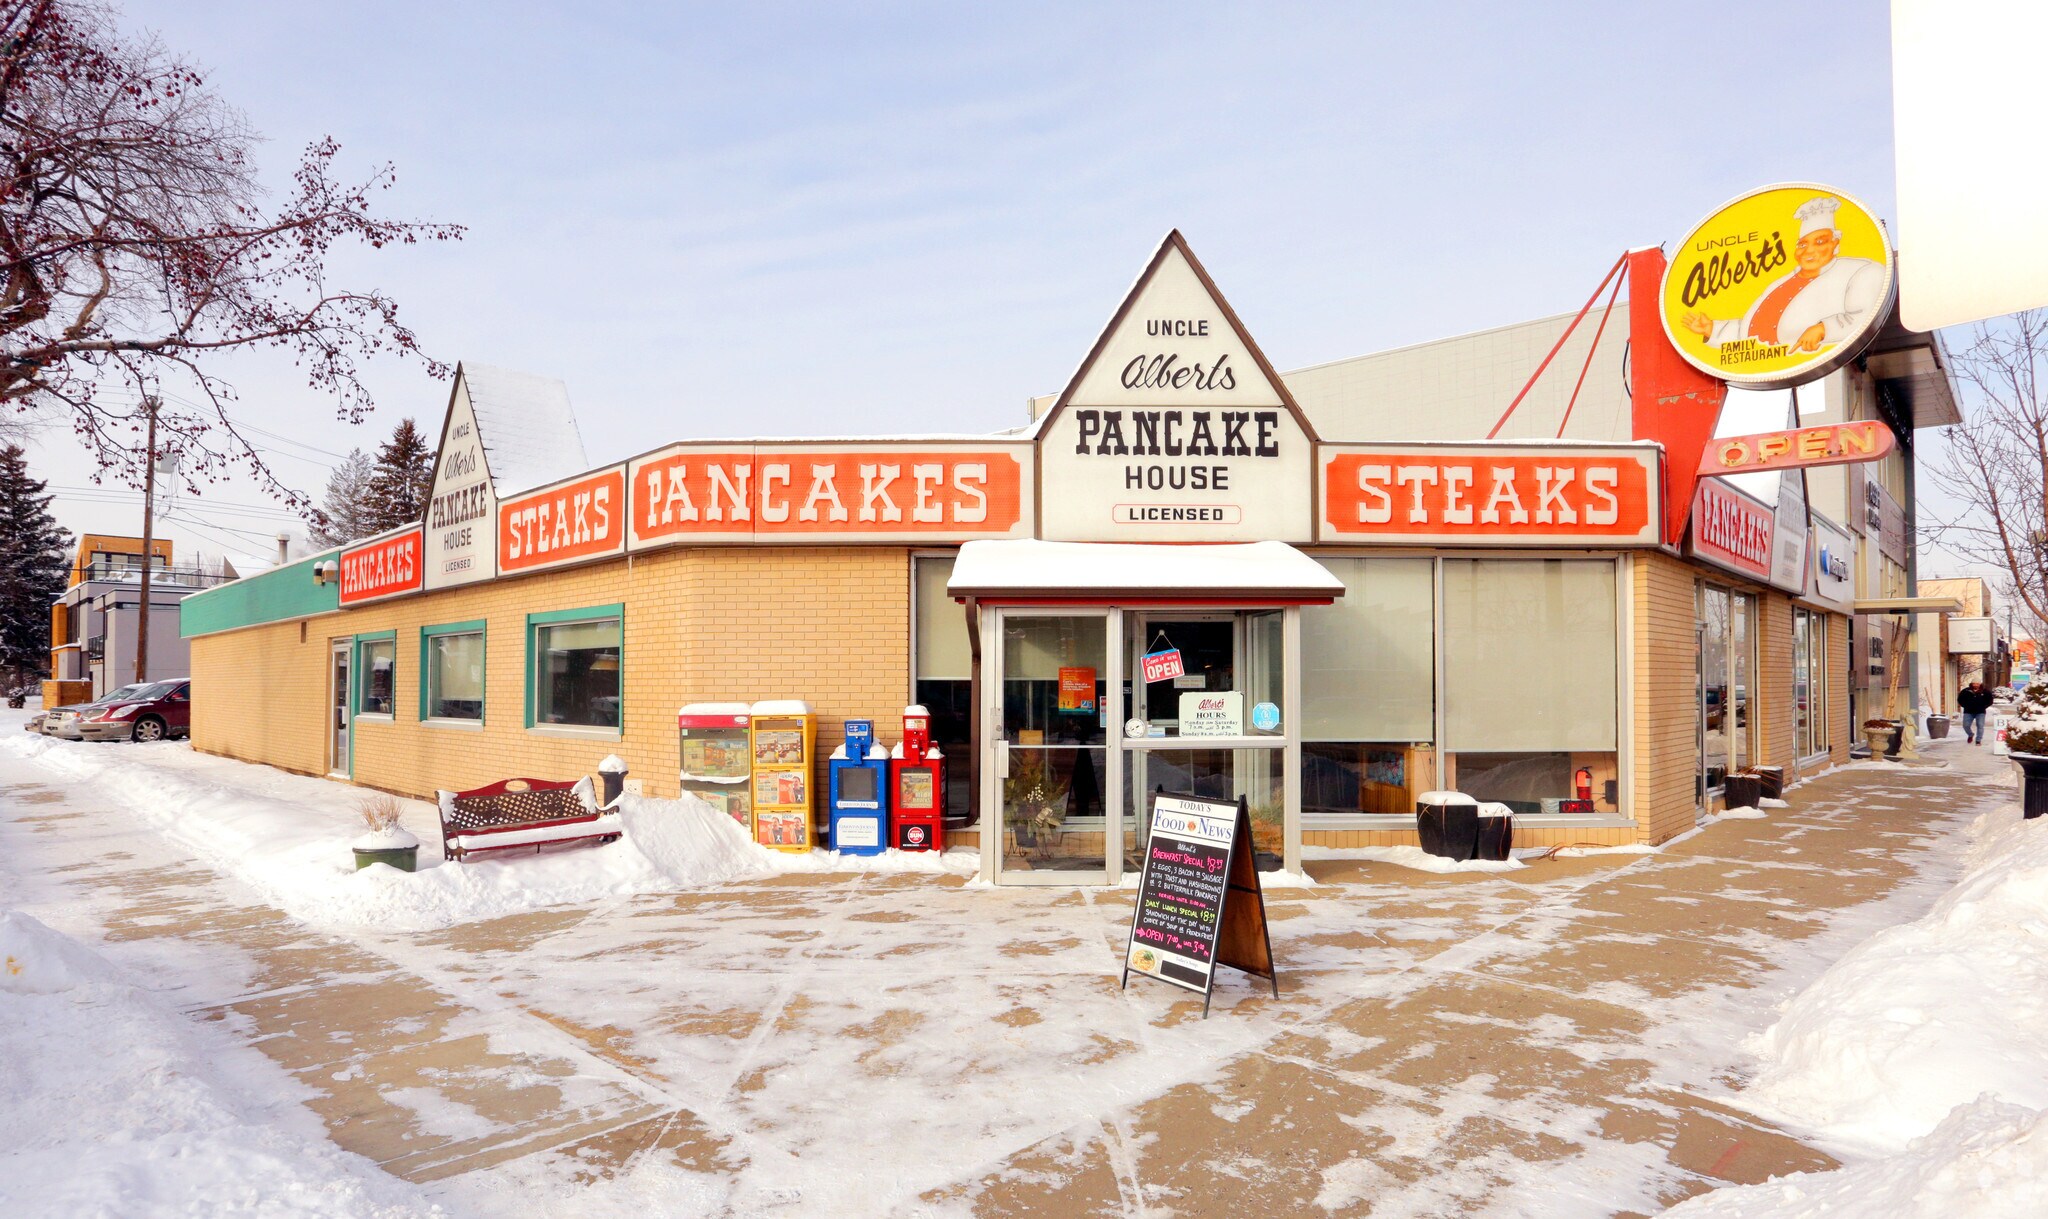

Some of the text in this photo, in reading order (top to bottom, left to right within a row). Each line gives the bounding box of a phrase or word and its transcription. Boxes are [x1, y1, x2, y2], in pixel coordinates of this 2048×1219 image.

[1697, 231, 1759, 252] UNCLE
[1681, 231, 1787, 308] Albert's
[1147, 320, 1209, 337] UNCLE
[1720, 345, 1788, 365] RESTAURANT
[1721, 338, 1756, 355] FAMILY
[1121, 353, 1236, 390] Alberts
[452, 422, 470, 440] UNCLE
[1075, 410, 1279, 457] PANCAKE
[1718, 426, 1875, 467] OPEN
[1125, 466, 1229, 491] HOUSE
[647, 463, 988, 529] PANCAKES
[1358, 464, 1618, 525] STEAKS
[432, 482, 487, 530] PANCAKE
[1129, 507, 1224, 521] LICENSED
[509, 485, 610, 560] STEAKS
[1702, 486, 1768, 567] PANCAKES
[443, 527, 472, 550] HOUSE
[343, 541, 414, 595] PANCAKES
[445, 558, 471, 573] LICENSED
[1147, 661, 1180, 679] OPEN
[1179, 800, 1212, 813] TODAY'S
[1562, 802, 1591, 813] OPEN
[909, 831, 924, 839] SUN
[1152, 847, 1183, 863] BREAKFAST
[1183, 853, 1205, 868] SPECIAL
[1150, 871, 1162, 879] WITH
[1164, 873, 1178, 883] TOAST
[1178, 877, 1187, 885] AND
[1178, 867, 1194, 877] BACON
[1201, 872, 1223, 884] SAUSAGE
[1163, 882, 1194, 896] BUTTERMILK
[1194, 889, 1218, 903] PANCAKES
[1145, 899, 1160, 909] DAILY
[1162, 903, 1177, 913] LUNCH
[1179, 907, 1198, 919] SPECIAL
[1145, 908, 1169, 921] SANDWICH
[1145, 928, 1164, 942] OPEN
[1166, 922, 1178, 931] SOUP
